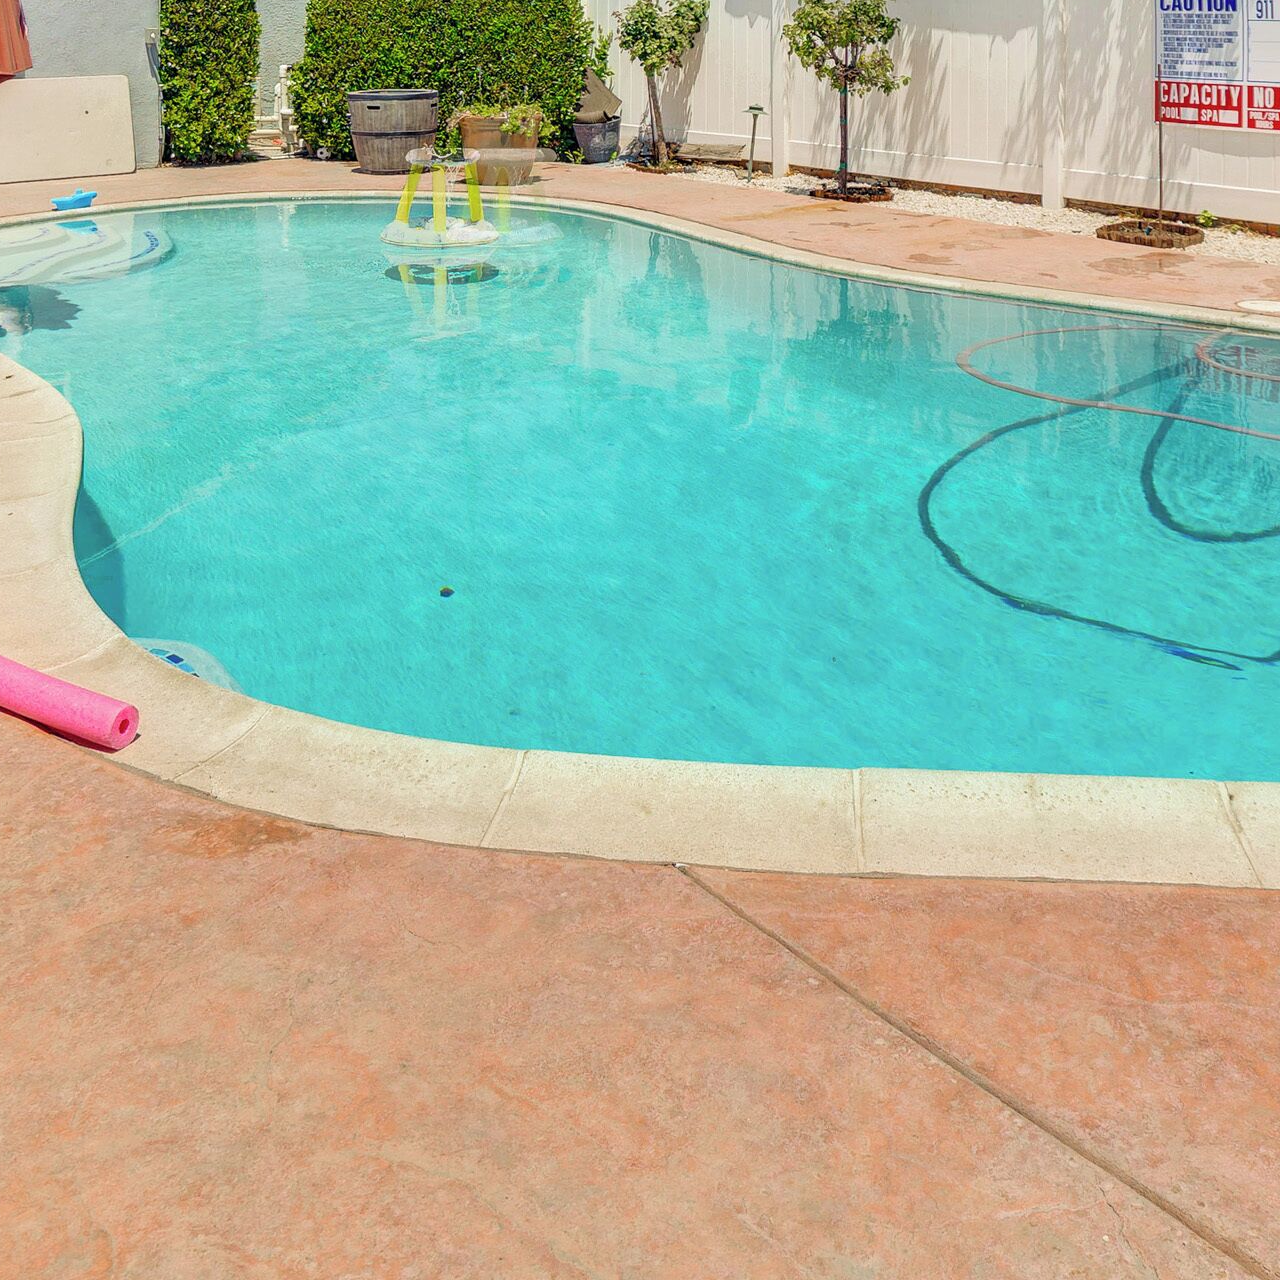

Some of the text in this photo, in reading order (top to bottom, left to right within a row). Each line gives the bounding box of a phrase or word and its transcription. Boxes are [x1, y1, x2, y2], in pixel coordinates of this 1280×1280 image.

[1255, 0, 1274, 19] 911
[1160, 82, 1241, 107] CAPACITY
[1253, 86, 1275, 109] NO
[1160, 106, 1180, 120] POOL
[1201, 109, 1220, 122] SPA
